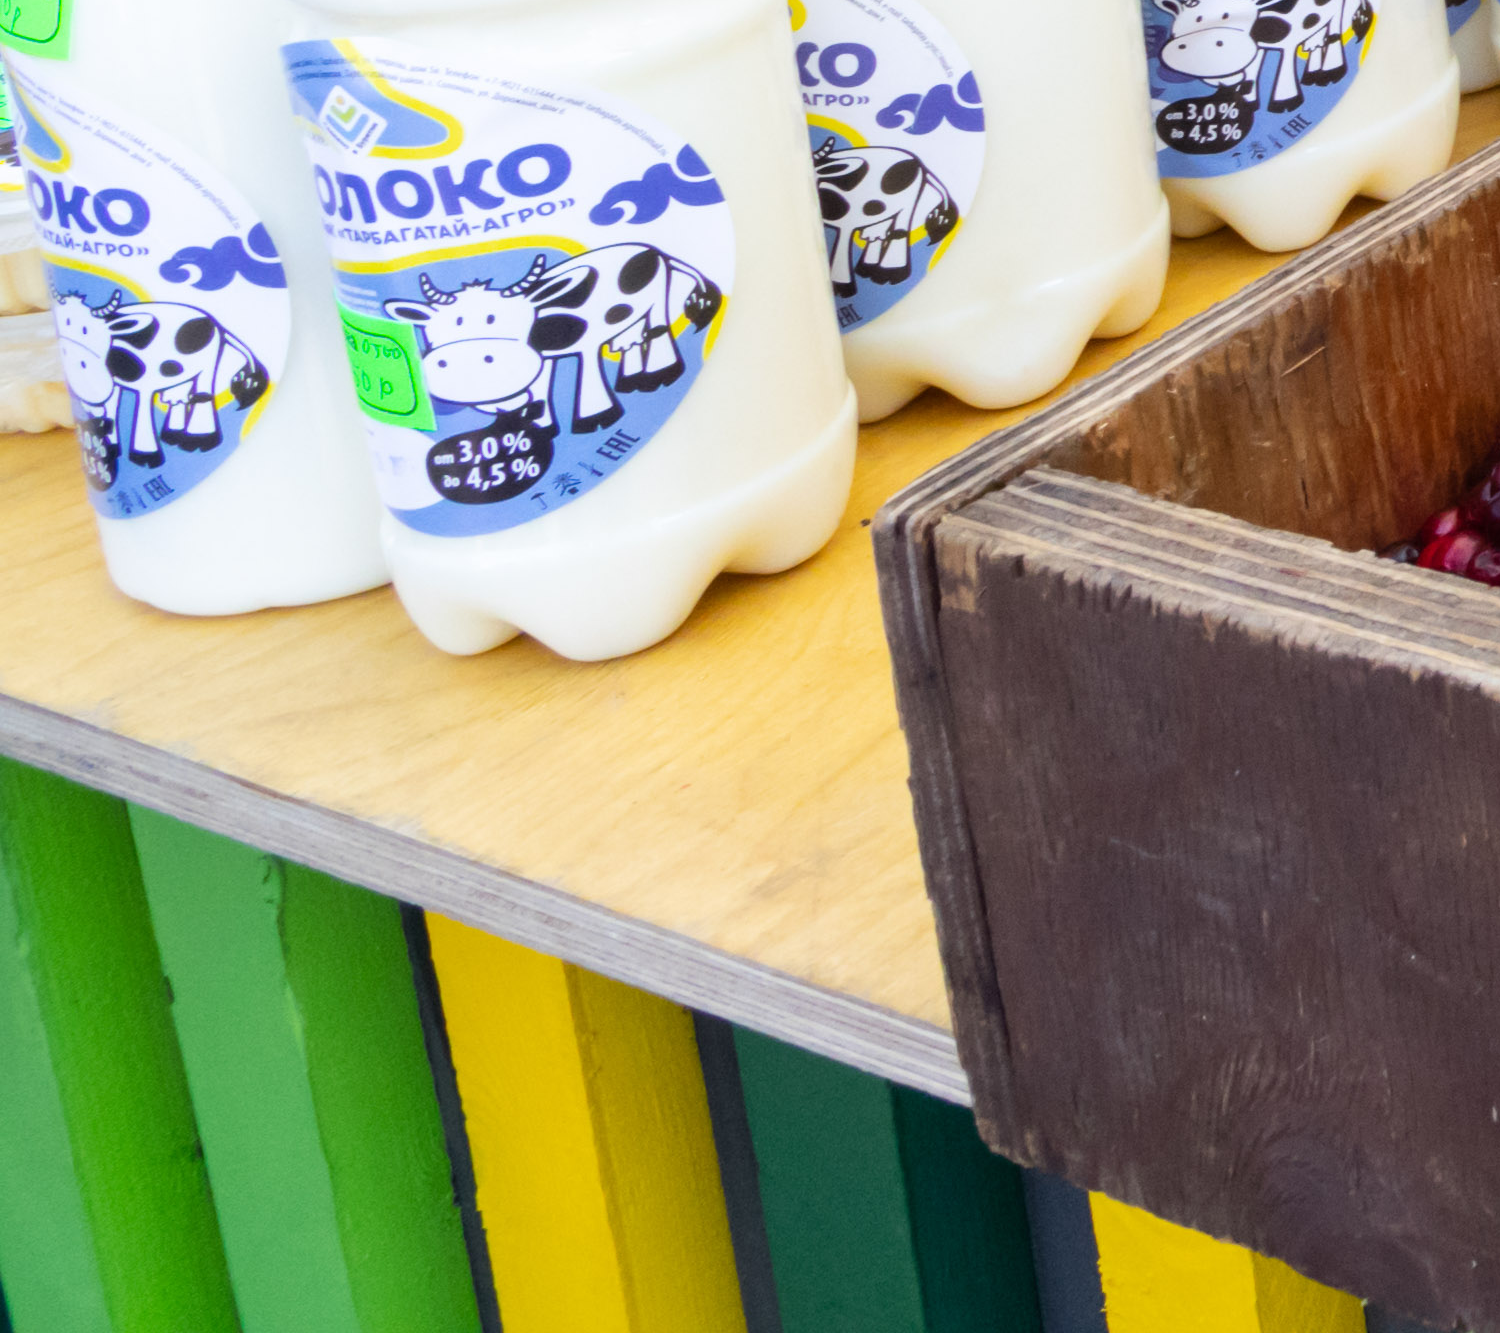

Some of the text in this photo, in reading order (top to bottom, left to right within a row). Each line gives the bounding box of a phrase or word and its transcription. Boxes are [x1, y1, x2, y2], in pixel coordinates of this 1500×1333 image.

[1186, 103, 1216, 122] 3,0
[1218, 102, 1239, 120] %
[1188, 124, 1218, 144] 4,5
[1221, 123, 1242, 141] %
[458, 439, 499, 464] 3,0
[502, 430, 533, 454] %
[466, 466, 507, 491] 4,5
[511, 456, 541, 480] %
